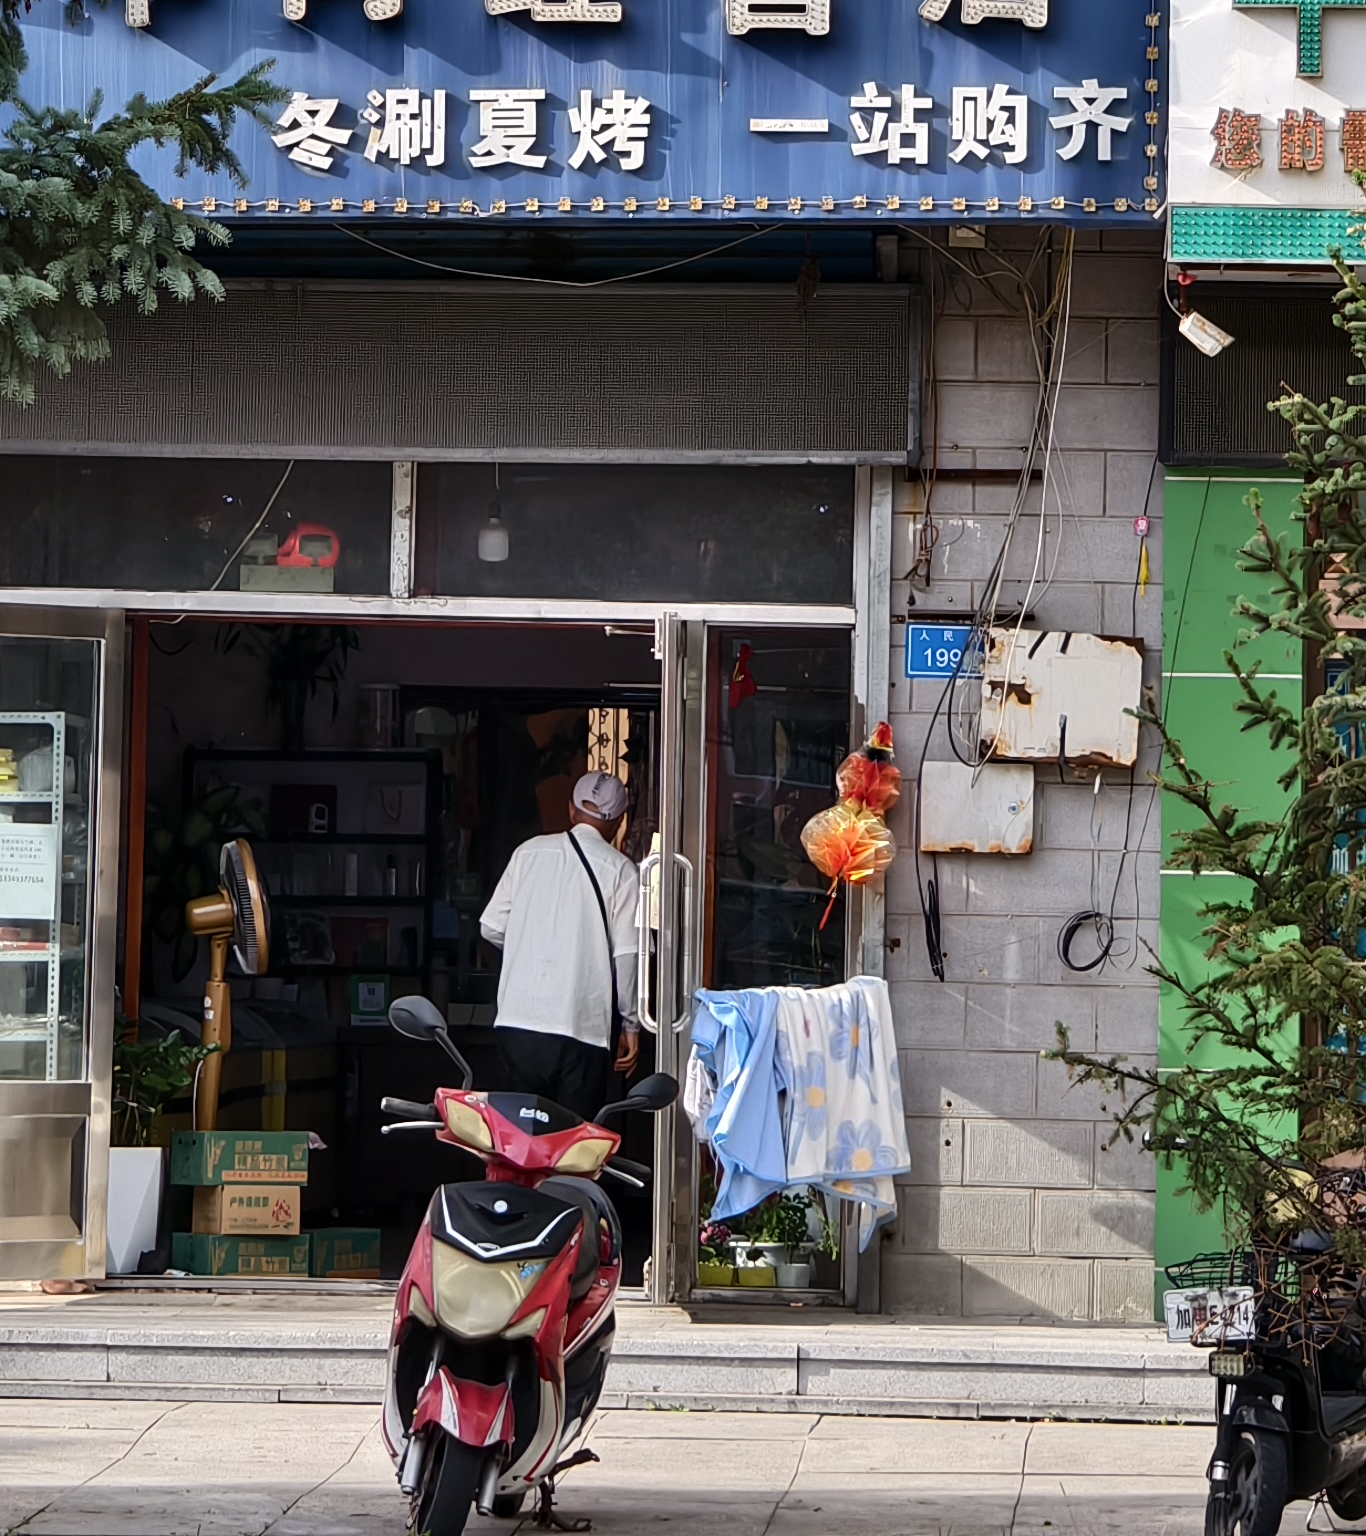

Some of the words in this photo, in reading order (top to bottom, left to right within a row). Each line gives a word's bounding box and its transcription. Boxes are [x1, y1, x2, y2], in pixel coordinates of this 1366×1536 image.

[271, 84, 653, 173] 冬涮夏烤
[749, 79, 1132, 166] 一站购齐
